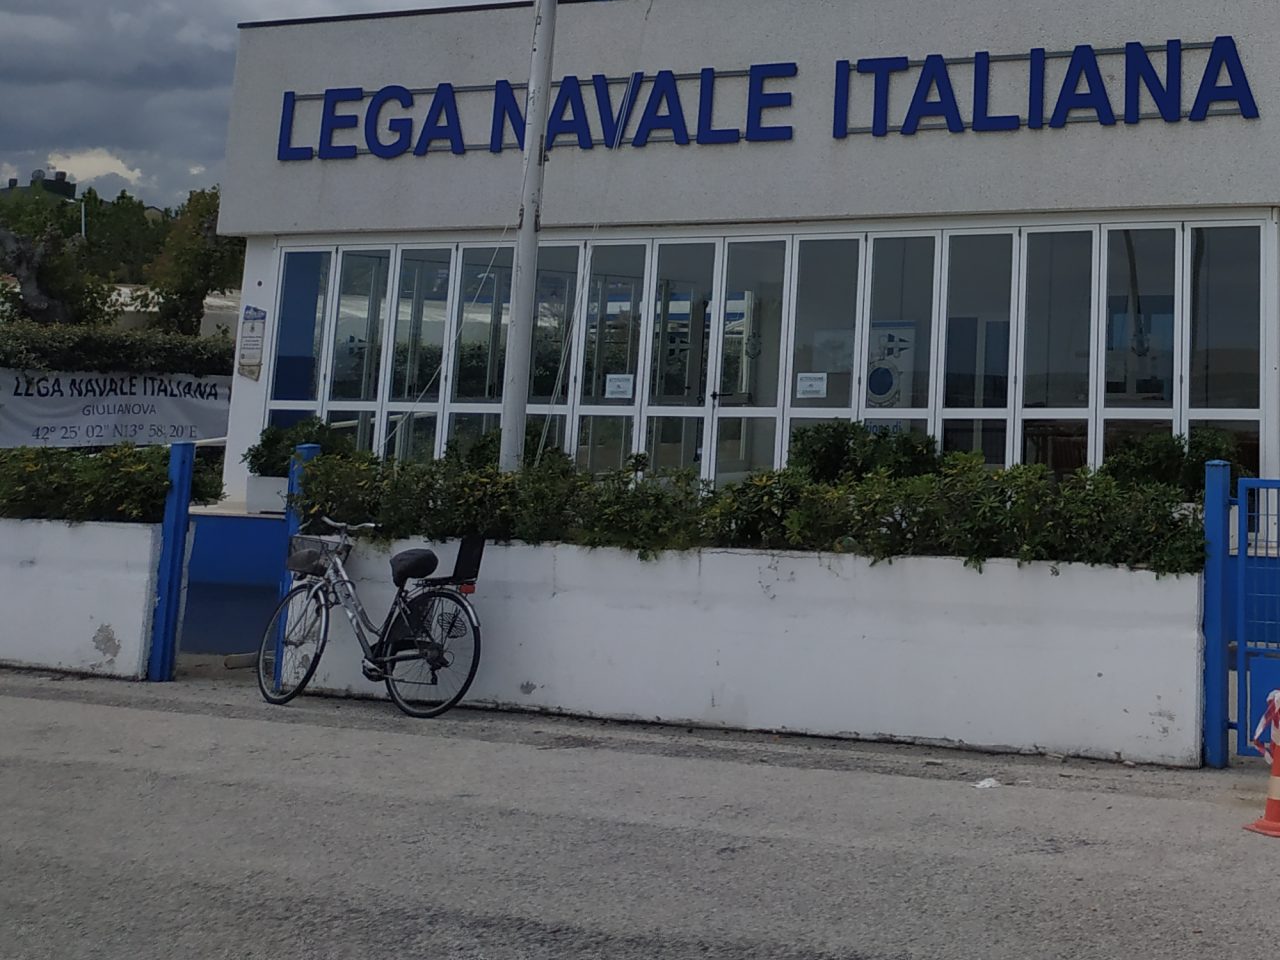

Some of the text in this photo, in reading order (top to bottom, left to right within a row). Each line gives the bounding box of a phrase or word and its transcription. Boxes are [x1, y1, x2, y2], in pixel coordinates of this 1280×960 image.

[277, 35, 1260, 161] LEGA NAVALE ITALIANA
[13, 376, 218, 401] LEGA NAVALE ITALIANA
[82, 403, 157, 416] GIULIANOVA
